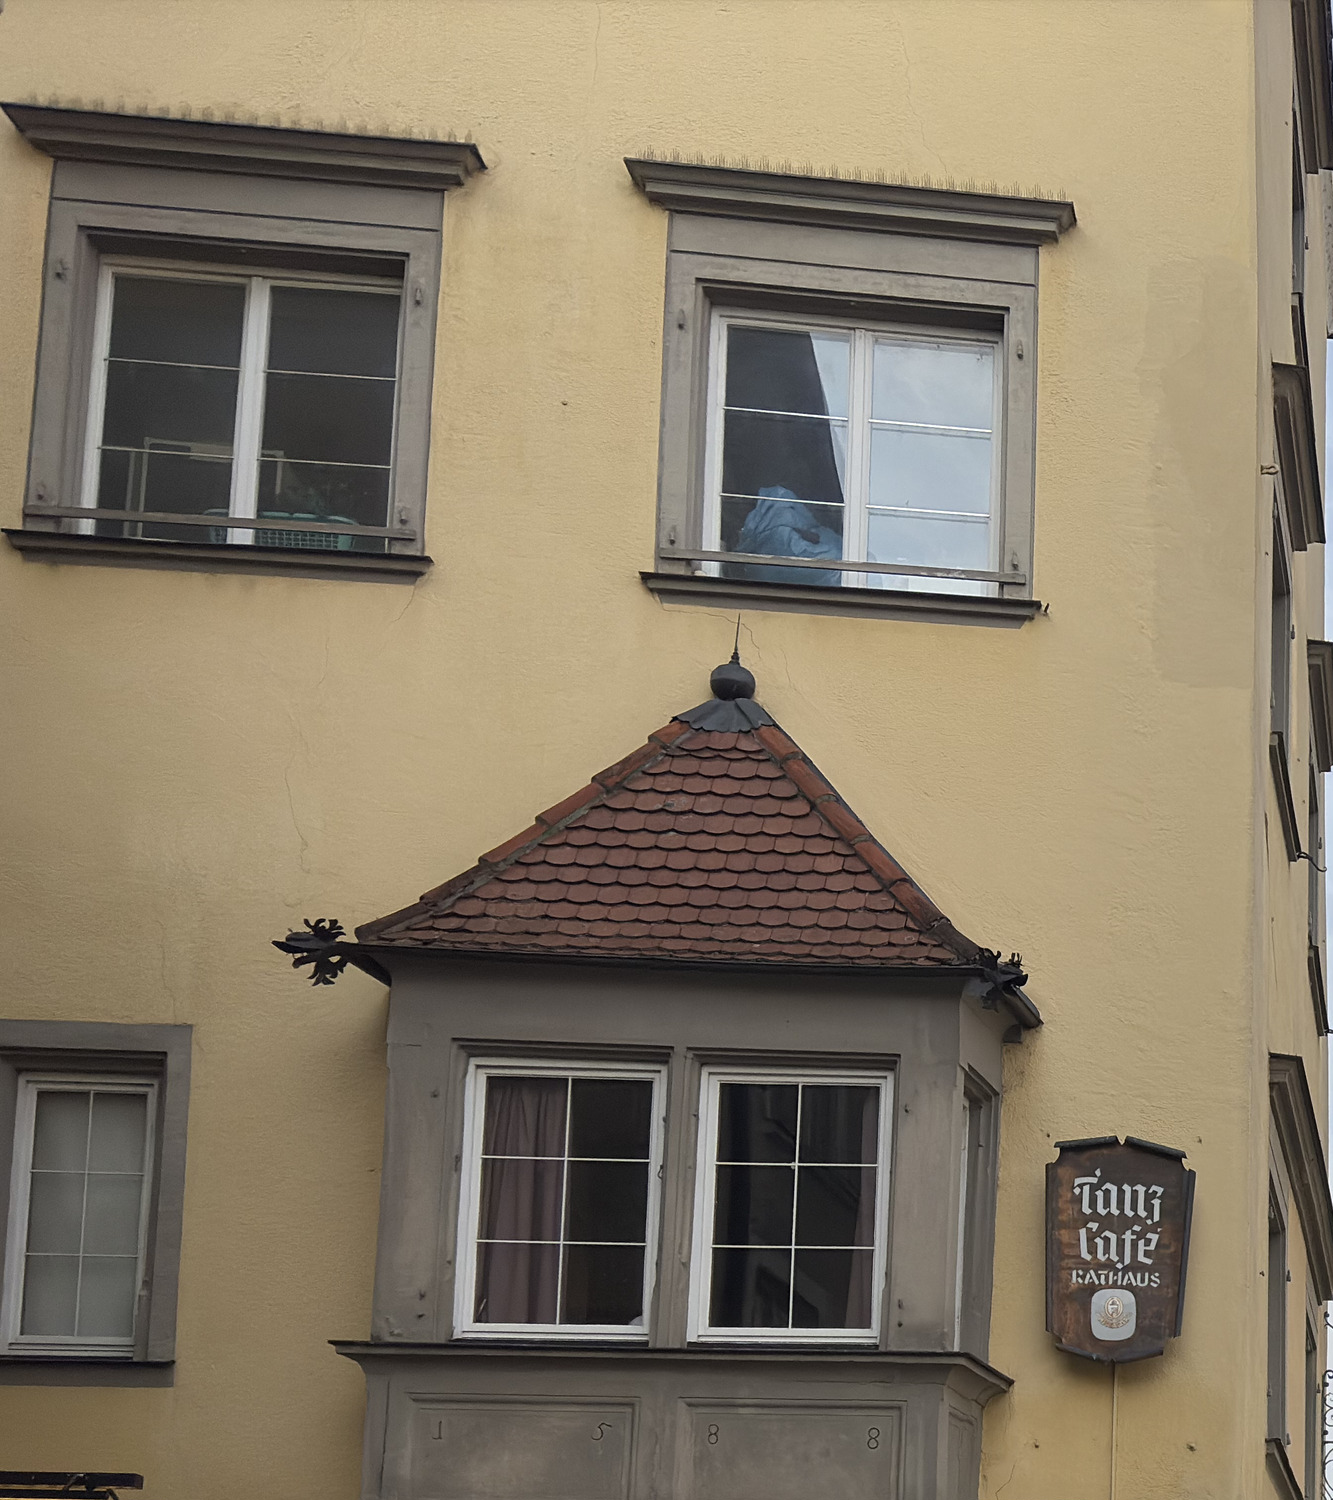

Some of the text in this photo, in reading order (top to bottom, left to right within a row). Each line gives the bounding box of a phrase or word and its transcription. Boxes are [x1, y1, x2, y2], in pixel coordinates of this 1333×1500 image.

[1073, 1168, 1165, 1225] Tanz
[1071, 1269, 1161, 1288] RATHAUS
[707, 1424, 719, 1445] 8
[866, 1427, 881, 1450] 8
